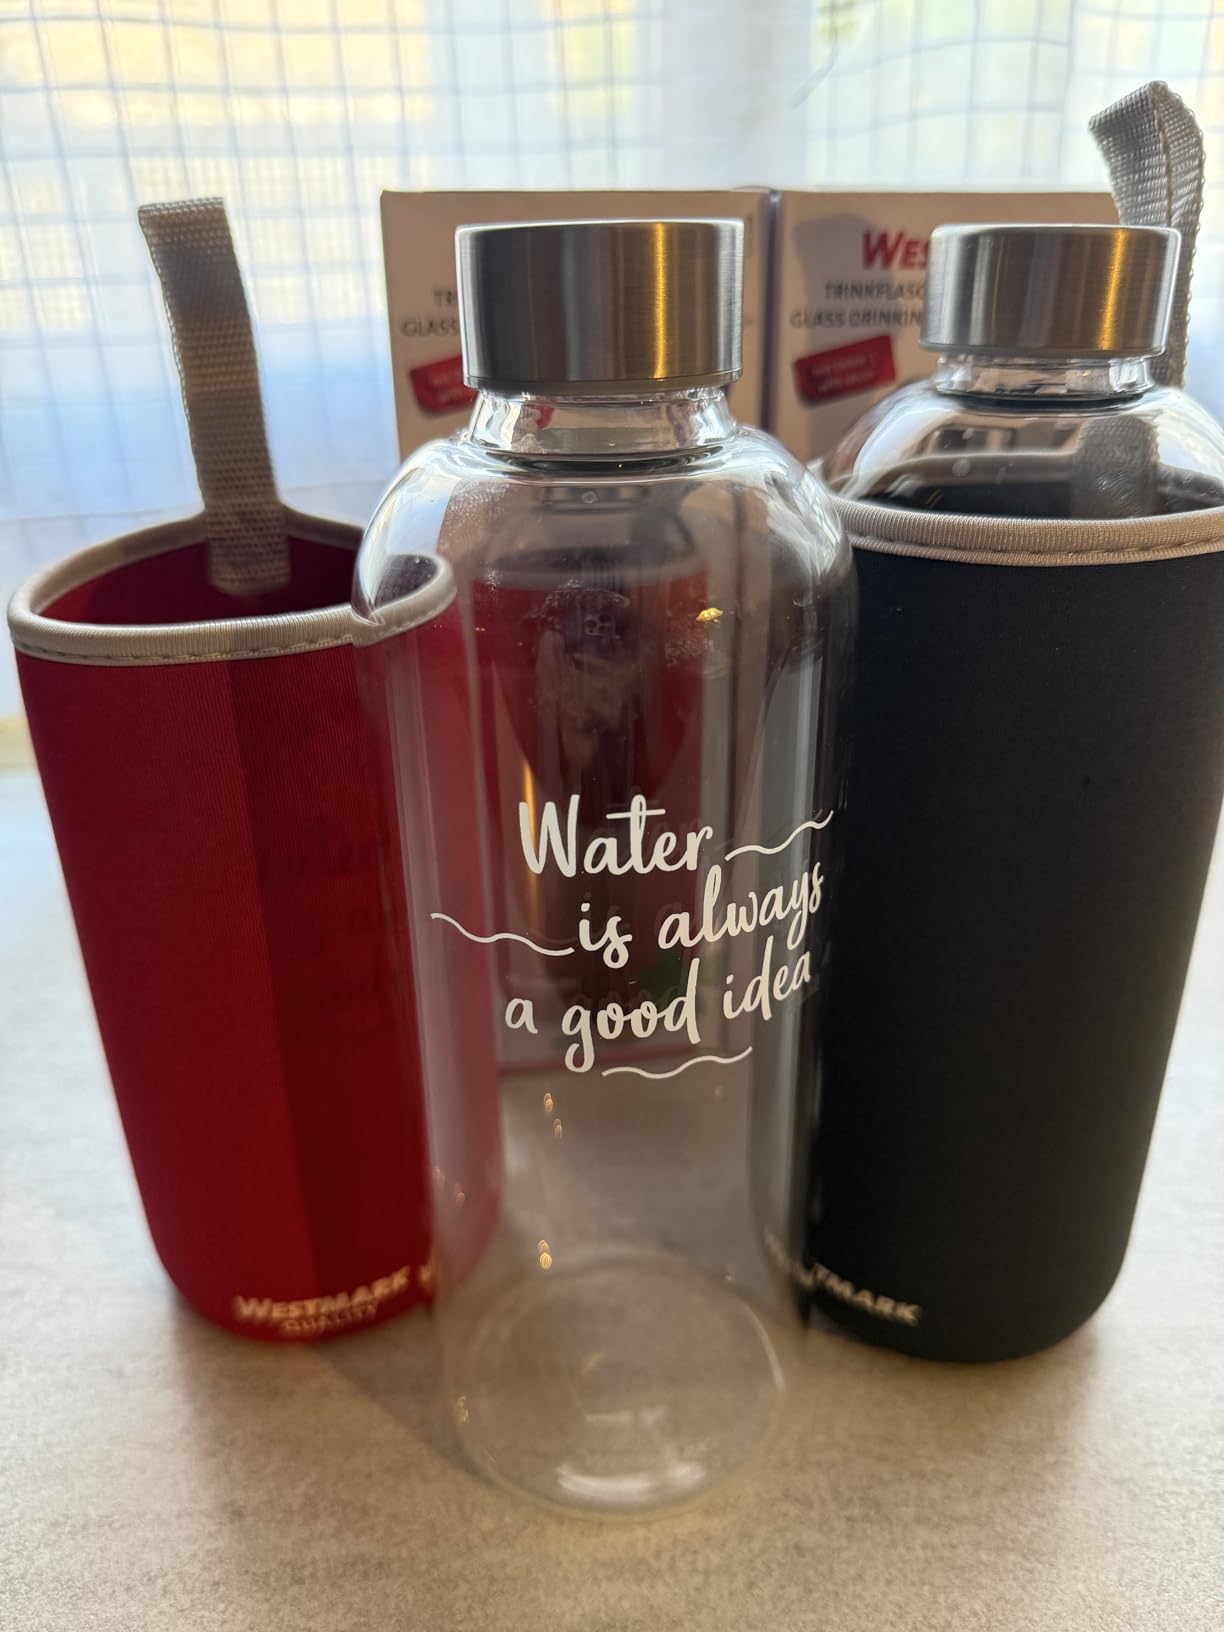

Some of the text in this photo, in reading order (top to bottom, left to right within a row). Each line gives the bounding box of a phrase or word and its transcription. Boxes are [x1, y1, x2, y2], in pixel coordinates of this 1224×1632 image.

[790, 310, 845, 329] GLASS
[518, 794, 713, 878] Water
[578, 861, 824, 969] is always
[504, 935, 811, 1073] a good idea
[234, 1264, 410, 1323] WESTMARK
[805, 1262, 922, 1327] TMARK
